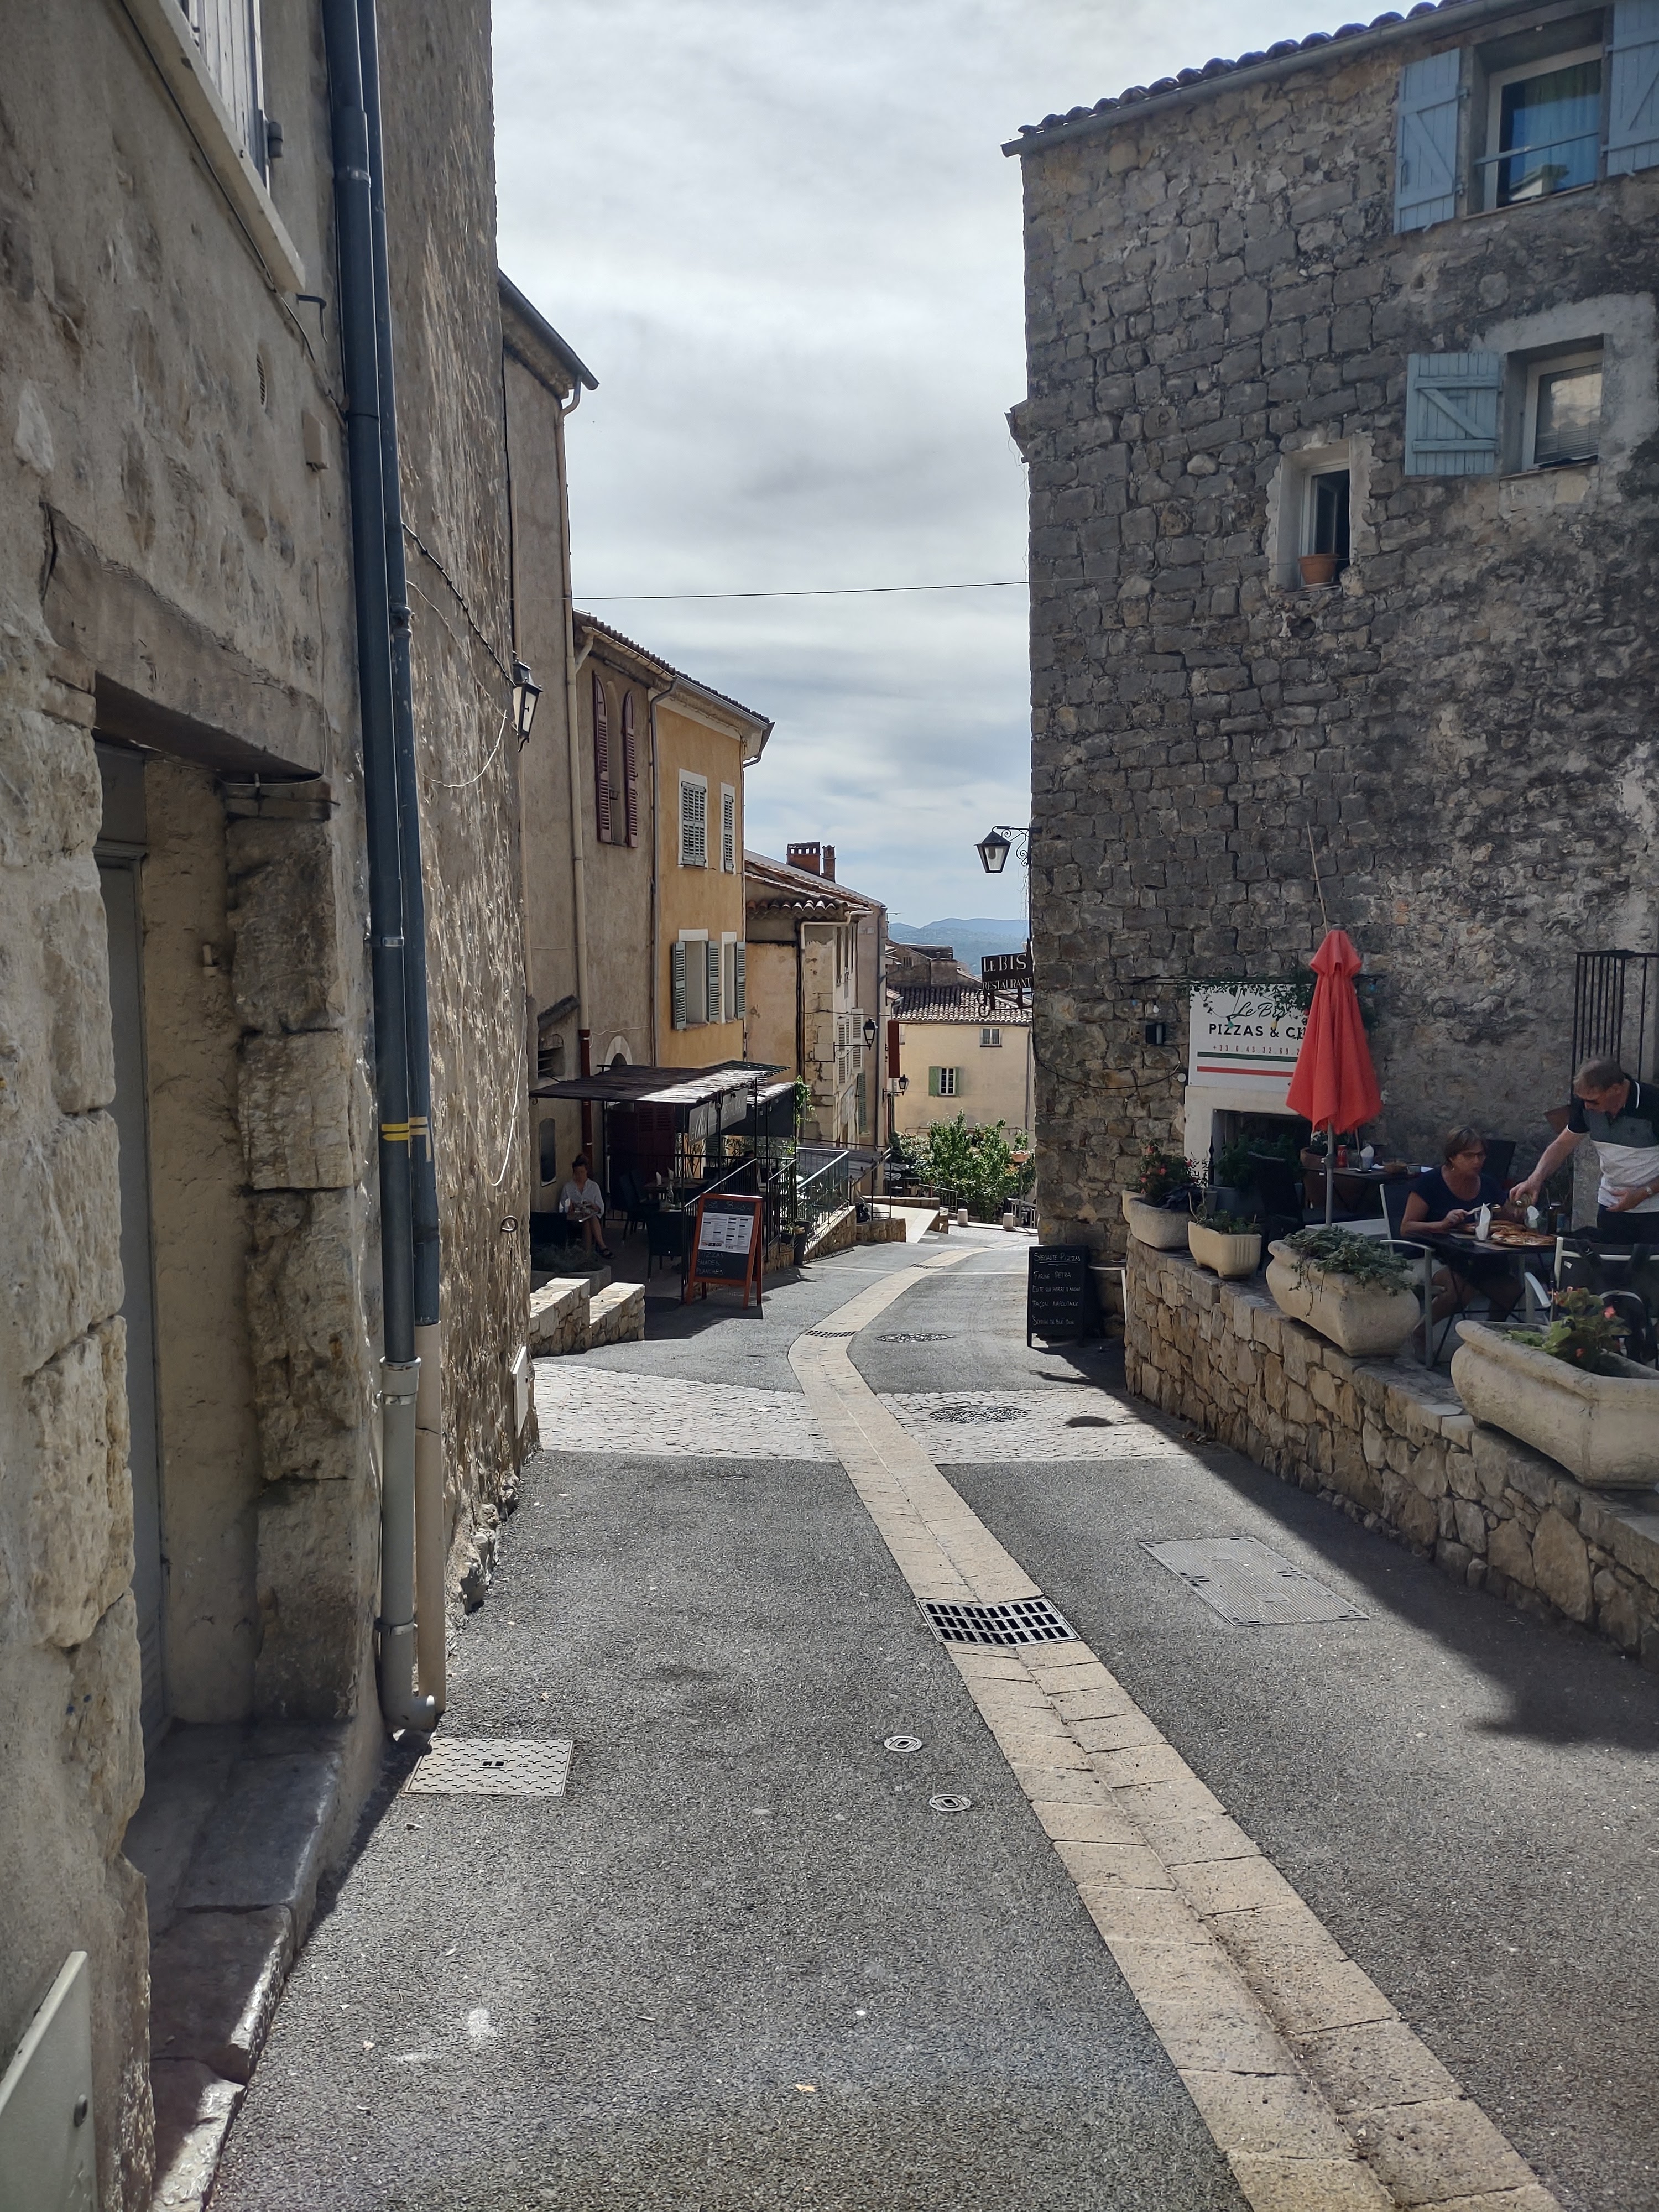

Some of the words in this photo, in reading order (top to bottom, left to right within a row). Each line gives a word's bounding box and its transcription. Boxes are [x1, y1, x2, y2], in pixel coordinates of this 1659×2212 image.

[999, 953, 1027, 971] BIS
[983, 977, 1032, 990] RESTAURANT
[1230, 1001, 1256, 1019] Le
[1209, 1024, 1264, 1037] PIZZAS
[1270, 1027, 1279, 1037] &
[1060, 1252, 1081, 1261] PIZZAS
